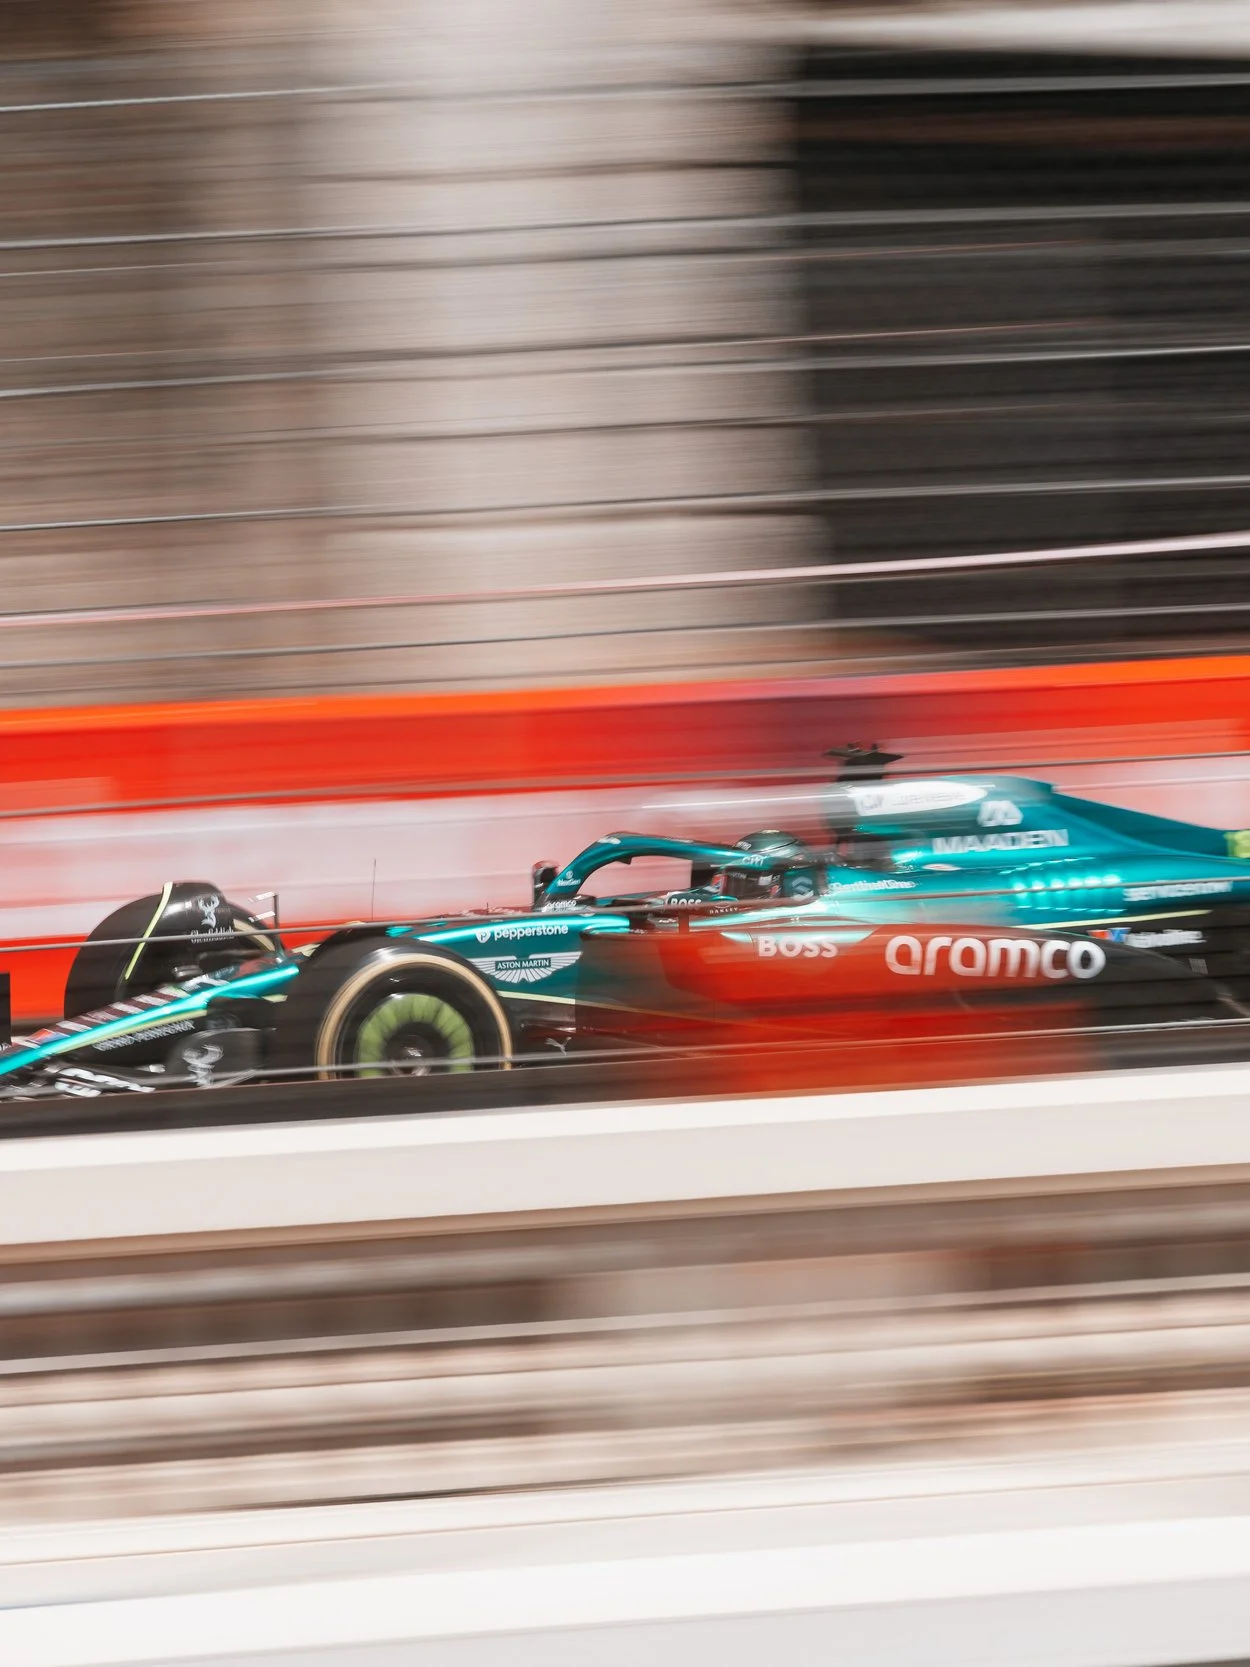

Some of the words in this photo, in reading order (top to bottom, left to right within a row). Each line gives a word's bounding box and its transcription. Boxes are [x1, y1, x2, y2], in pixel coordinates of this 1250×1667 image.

[494, 924, 568, 940] pepperstone
[757, 935, 838, 958] BOSS
[497, 960, 520, 970] ASTON
[522, 959, 549, 968] MARTIN
[885, 935, 1107, 979] aramco
